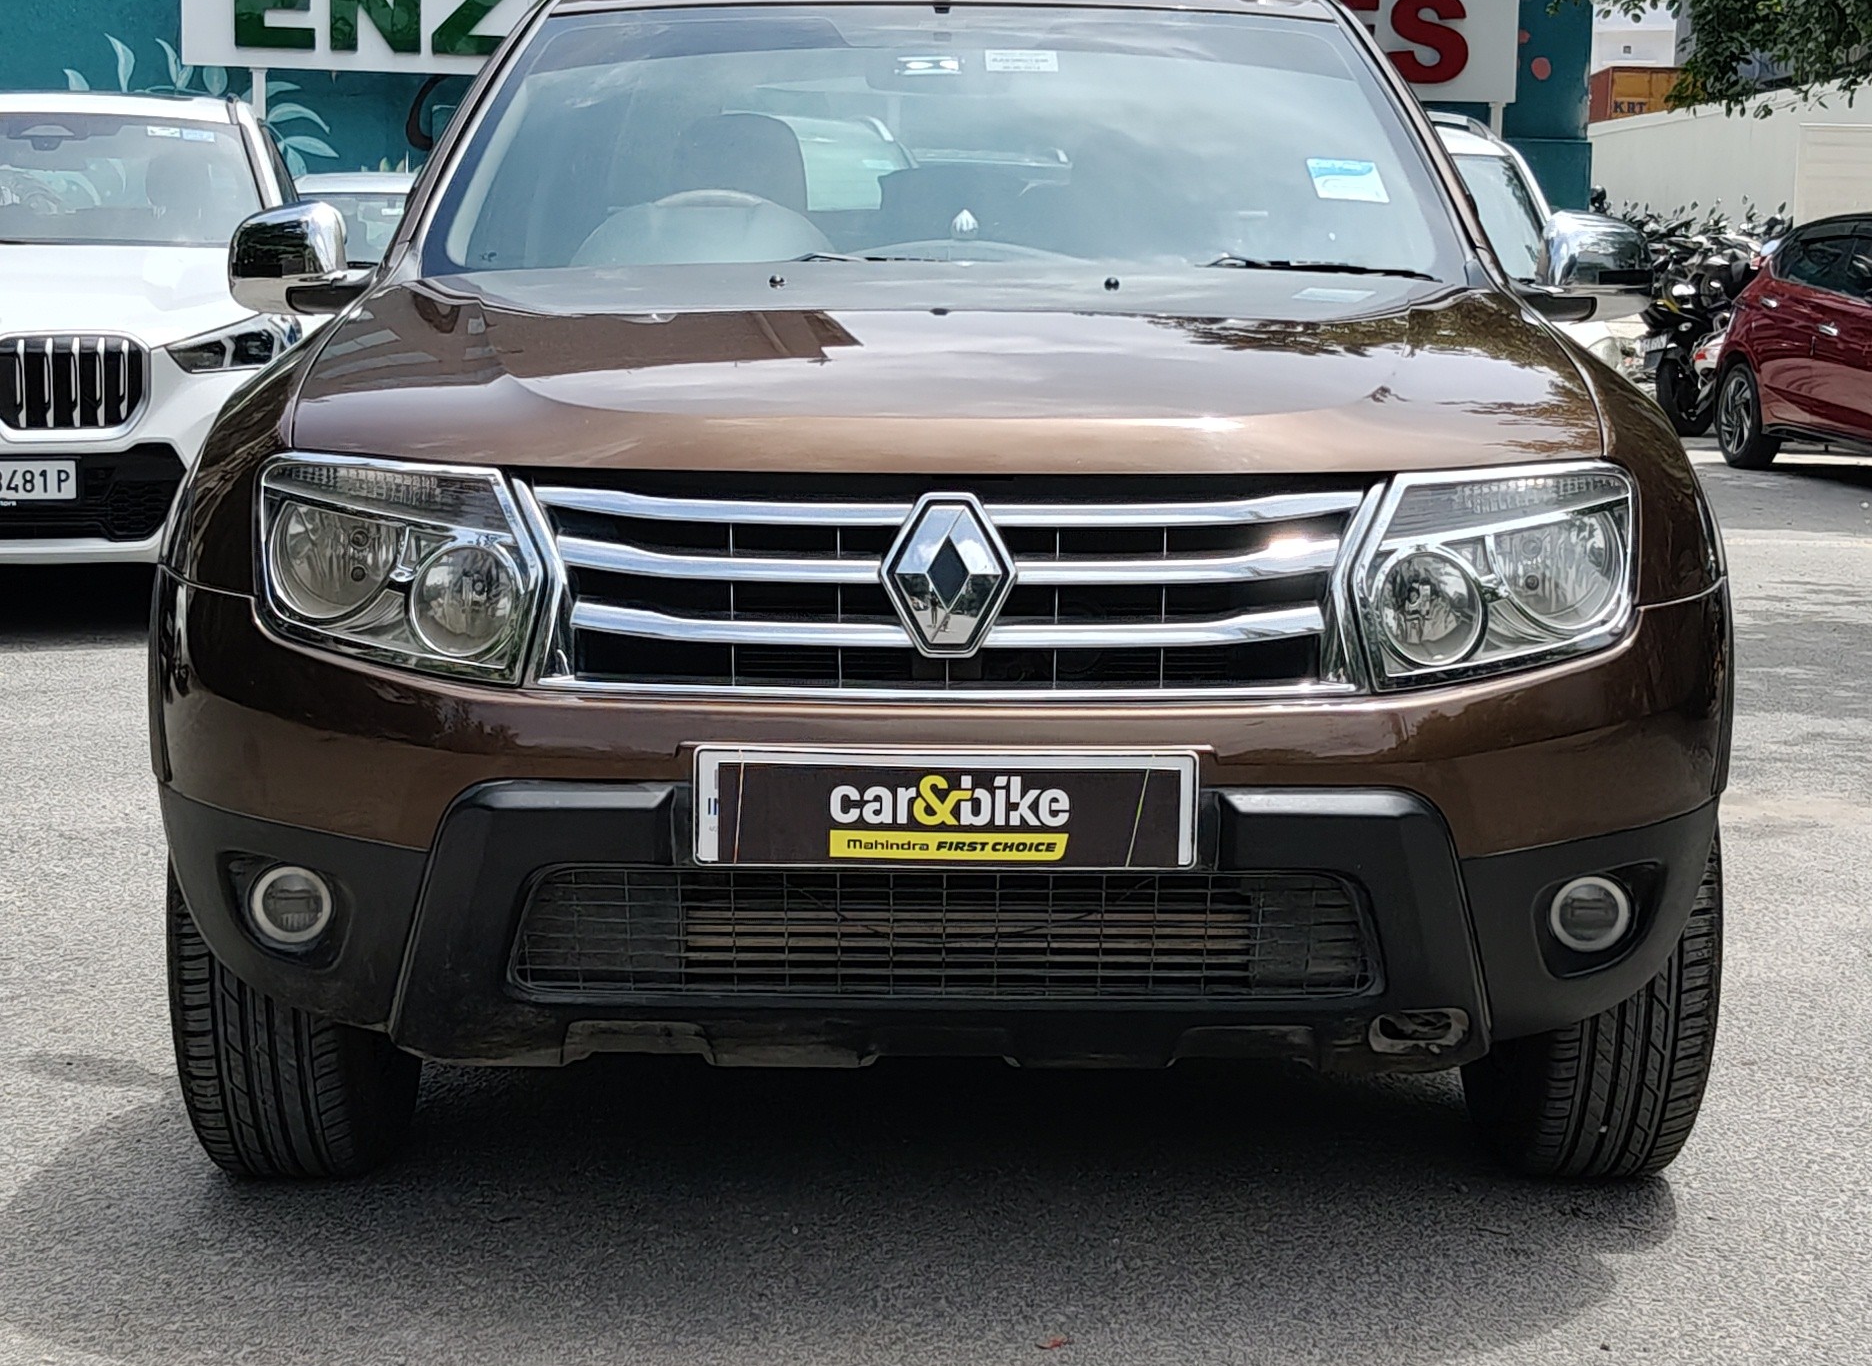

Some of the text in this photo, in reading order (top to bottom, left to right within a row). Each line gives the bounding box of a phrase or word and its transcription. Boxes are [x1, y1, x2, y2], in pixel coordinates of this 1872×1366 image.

[829, 774, 1070, 826] car&bike
[847, 838, 1058, 853] Mahindra FIRST CHOICE
